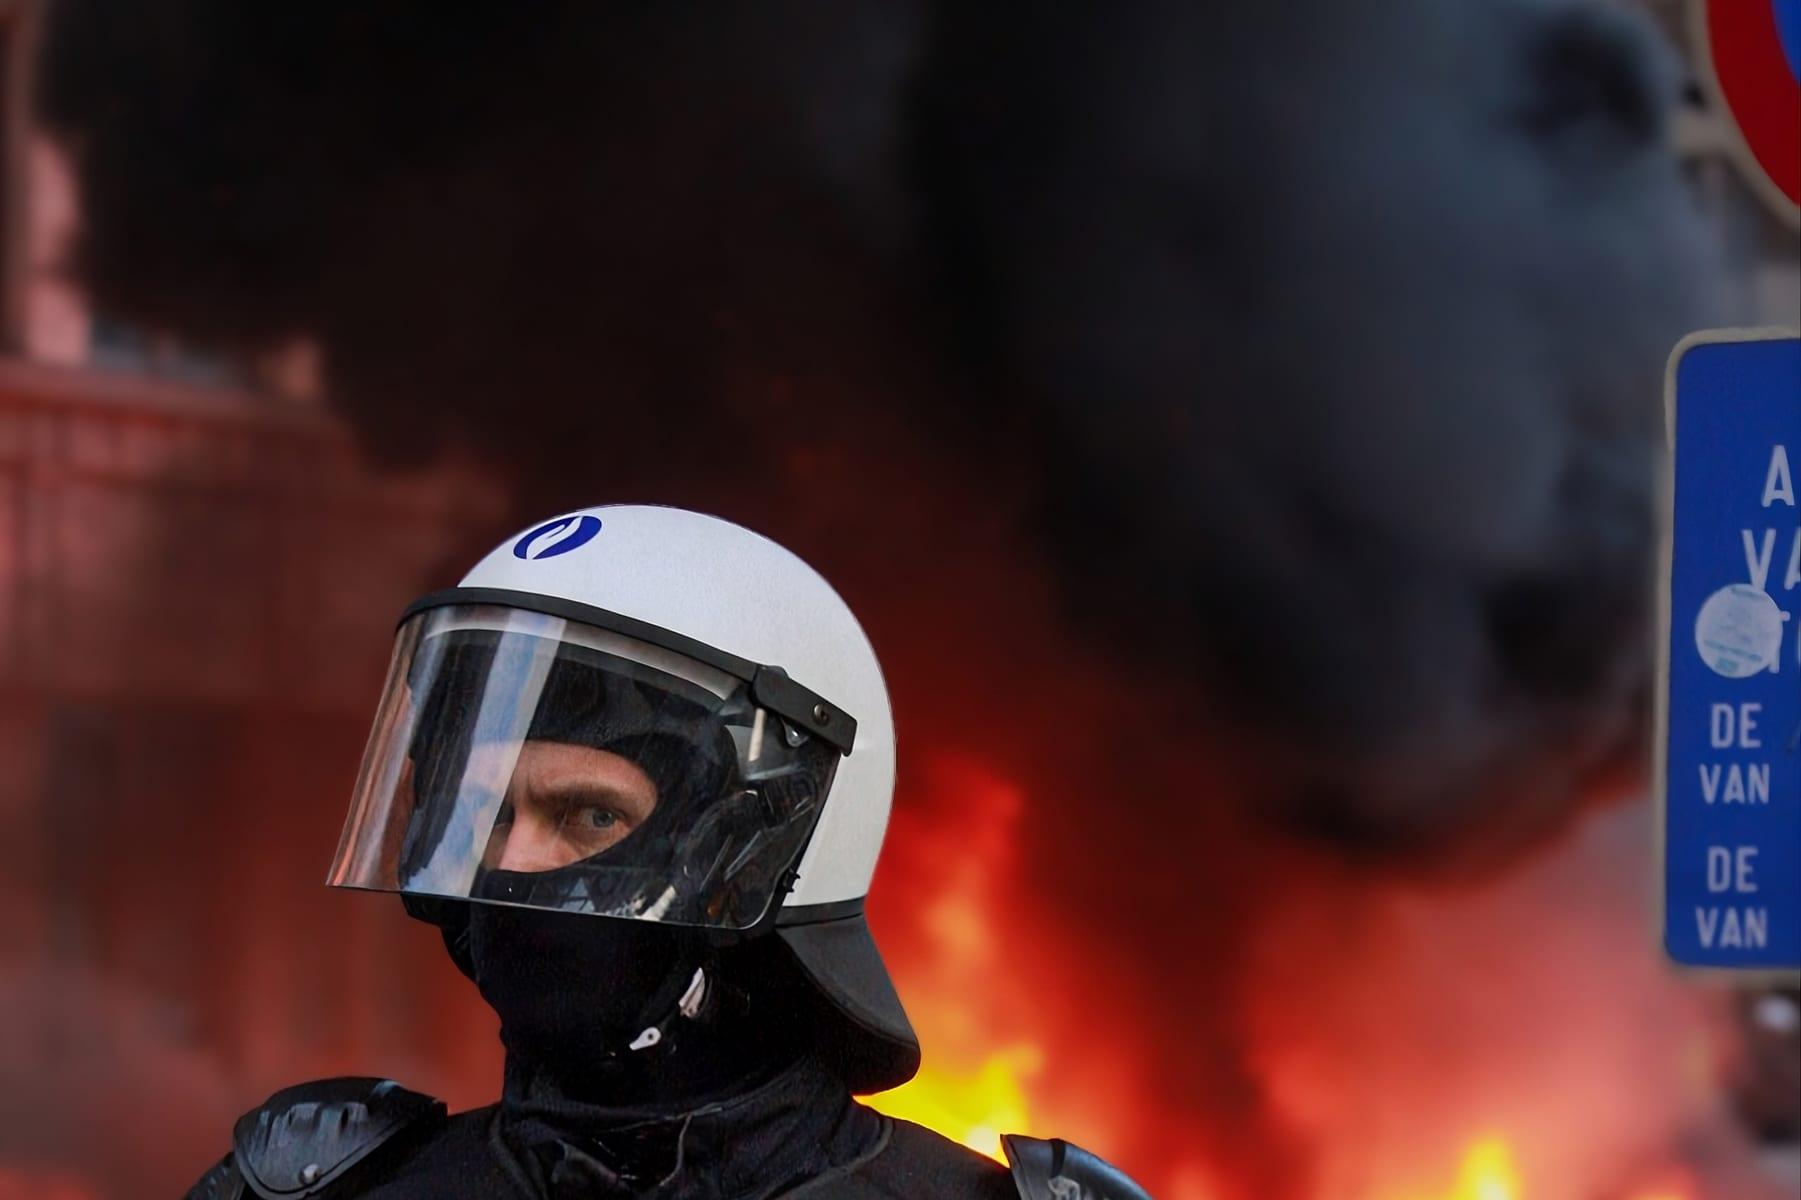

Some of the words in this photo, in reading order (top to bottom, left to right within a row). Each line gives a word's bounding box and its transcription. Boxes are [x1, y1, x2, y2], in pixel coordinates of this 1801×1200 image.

[1761, 445, 1796, 507] A
[1710, 702, 1762, 748] DE
[1699, 763, 1770, 804] VAN
[1706, 845, 1758, 892] DE
[1695, 905, 1768, 948] VAN
